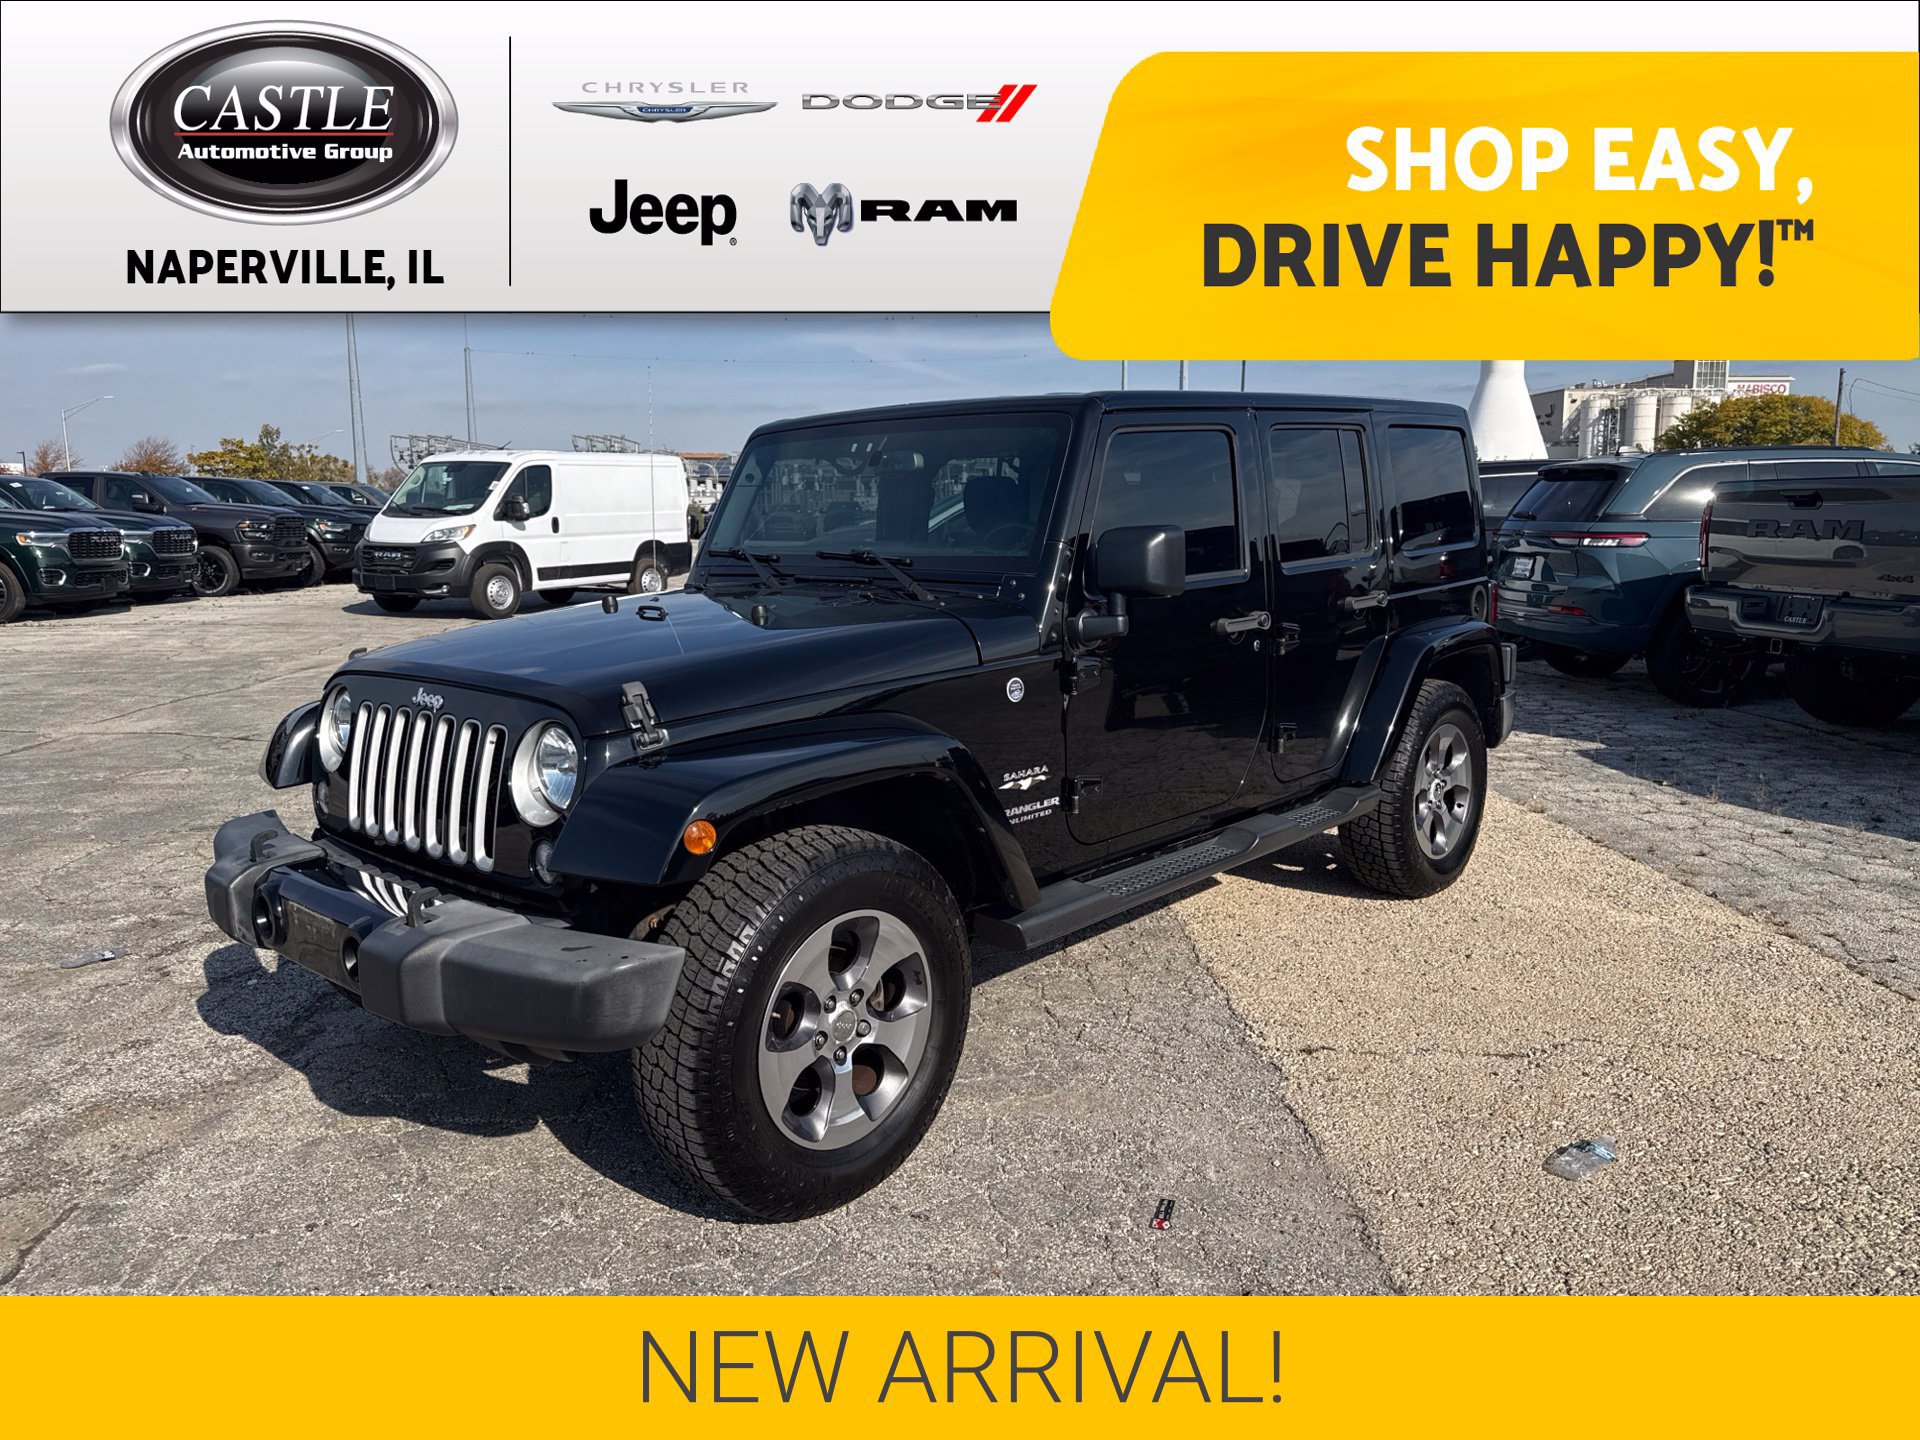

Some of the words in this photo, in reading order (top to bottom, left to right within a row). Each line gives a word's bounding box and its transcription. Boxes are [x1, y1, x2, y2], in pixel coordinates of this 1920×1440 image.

[1746, 519, 1865, 541] RAM
[412, 687, 444, 713] Jeep
[1003, 765, 1049, 782] SAHARA
